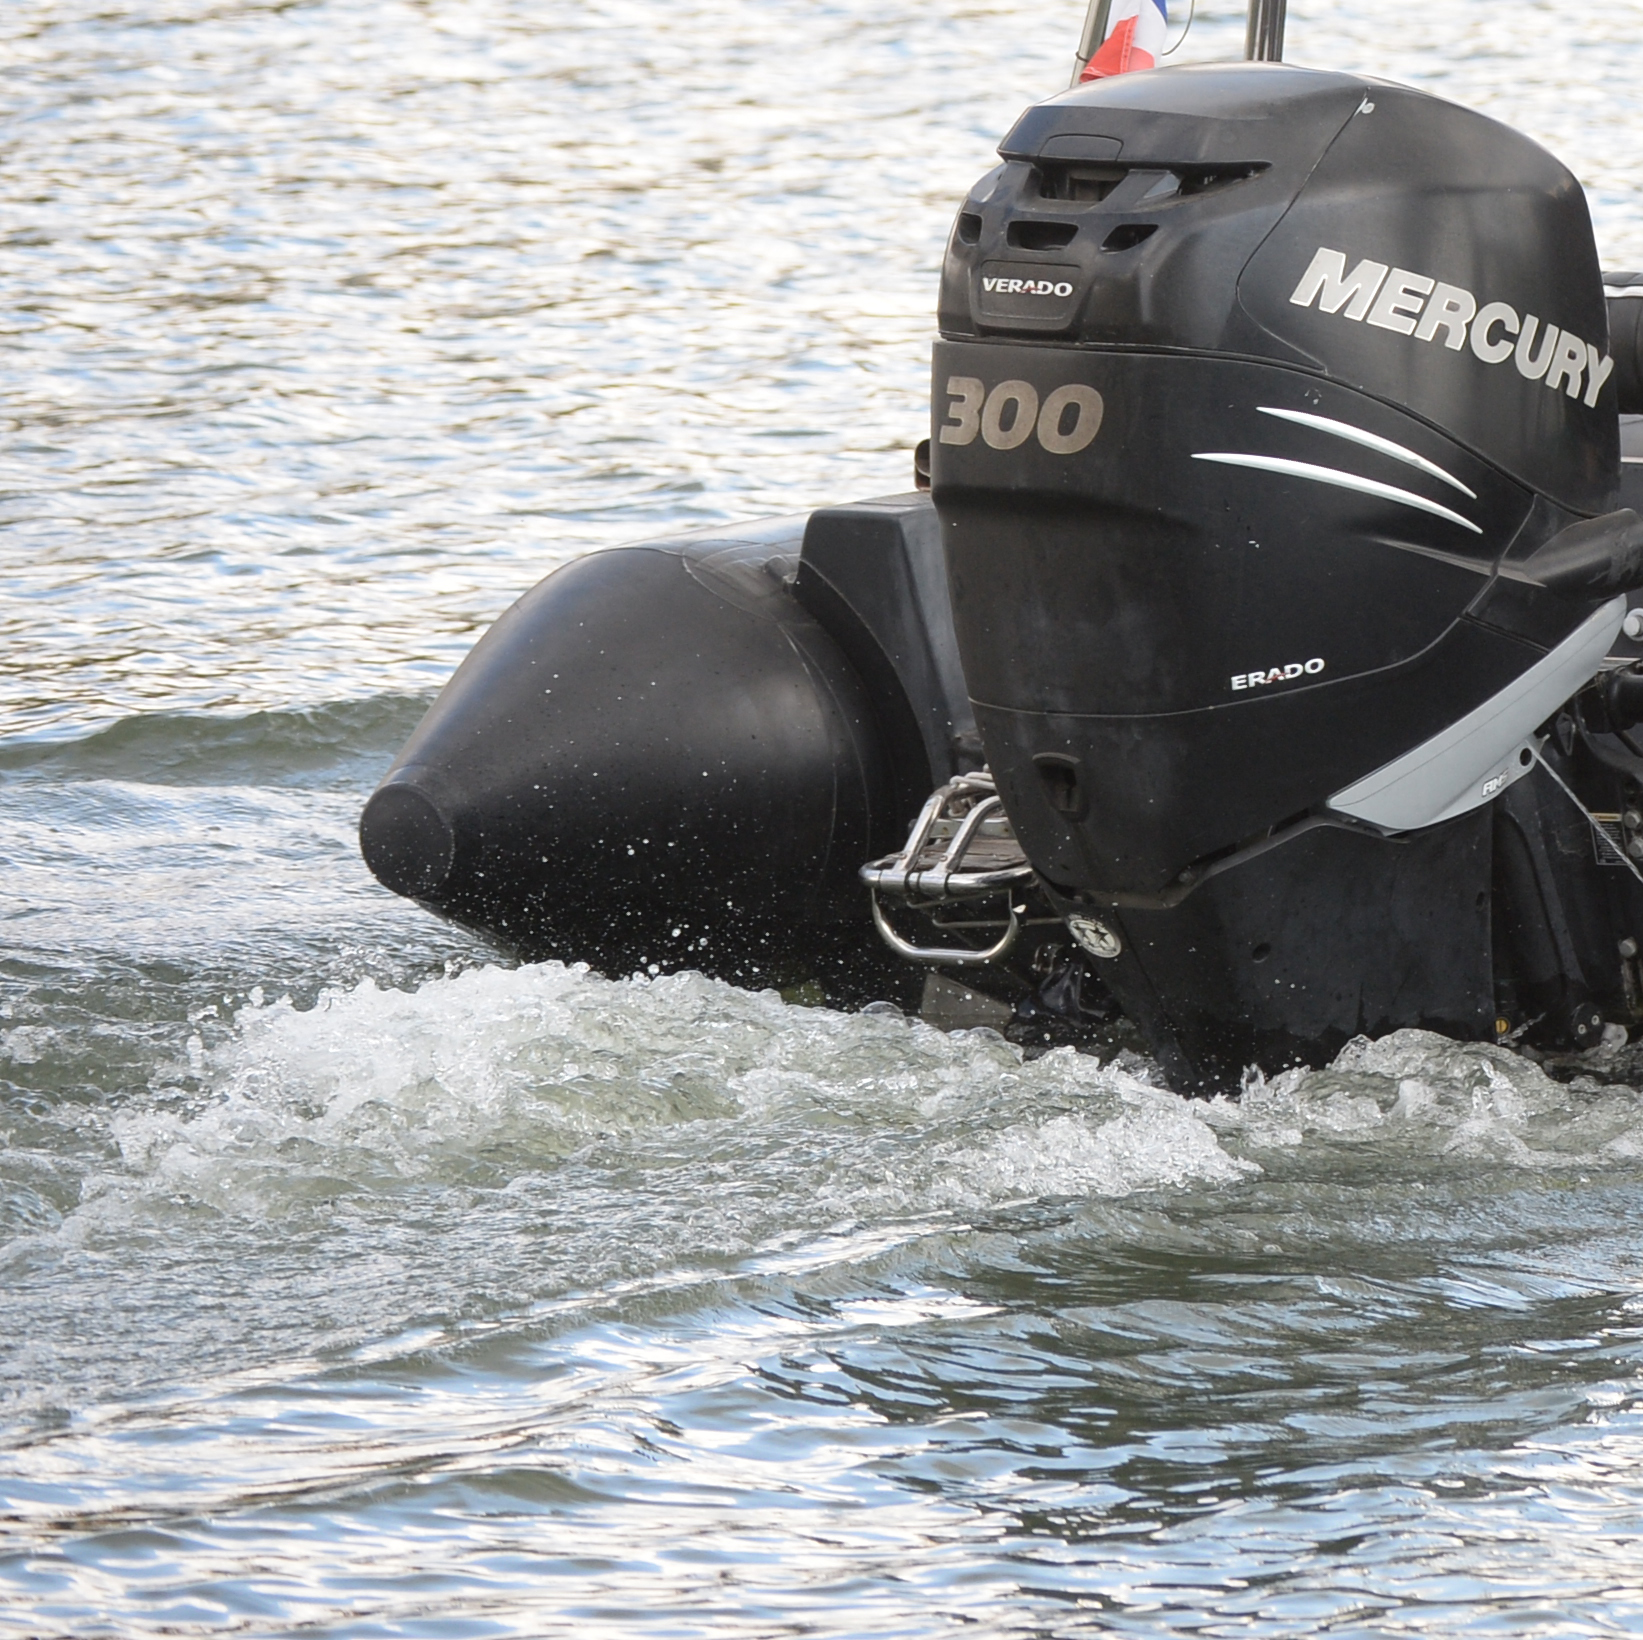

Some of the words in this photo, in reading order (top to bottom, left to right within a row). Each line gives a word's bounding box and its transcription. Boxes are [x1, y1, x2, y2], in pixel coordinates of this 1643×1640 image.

[982, 277, 1073, 297] VERADO
[1289, 247, 1614, 408] MERCURY
[939, 375, 1104, 454] 300
[1230, 657, 1325, 691] ERADO
